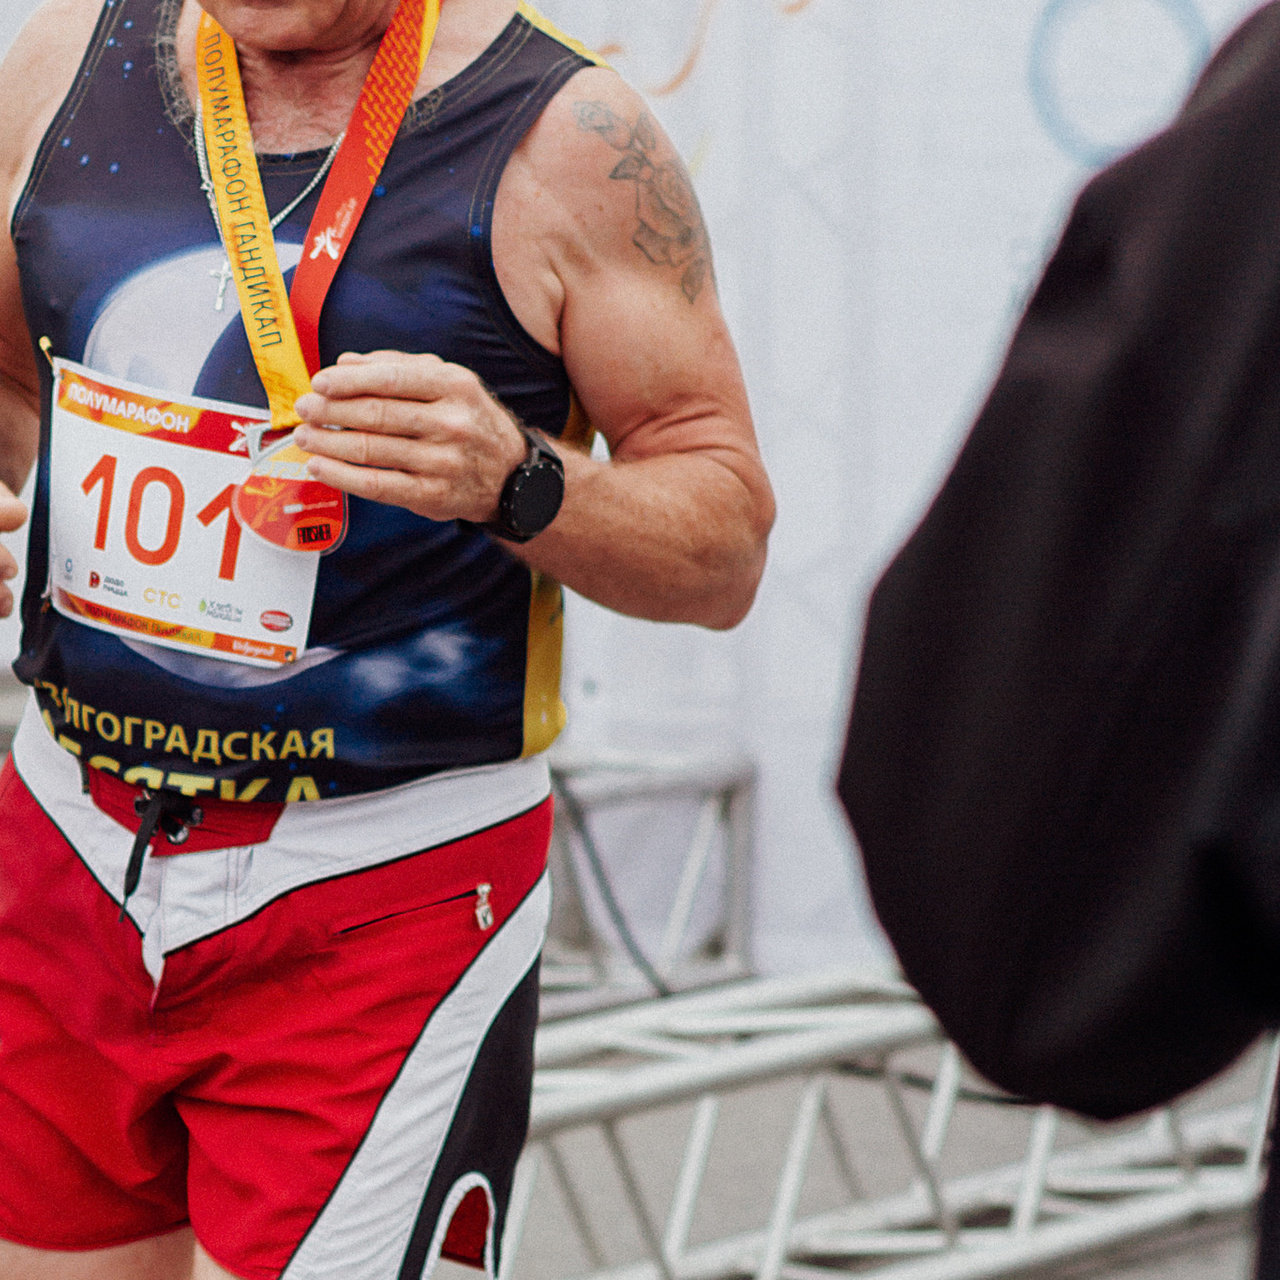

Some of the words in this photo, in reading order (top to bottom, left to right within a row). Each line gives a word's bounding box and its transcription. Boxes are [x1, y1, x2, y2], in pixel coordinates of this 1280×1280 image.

[203, 32, 253, 216] ПОЛУМАРАФОН
[233, 221, 284, 349] ГАНДИКАП
[67, 381, 191, 434] ПОЛУМАРАФОН
[80, 453, 243, 582] 101
[34, 680, 336, 766] ЛГОГРАДСКАЯ
